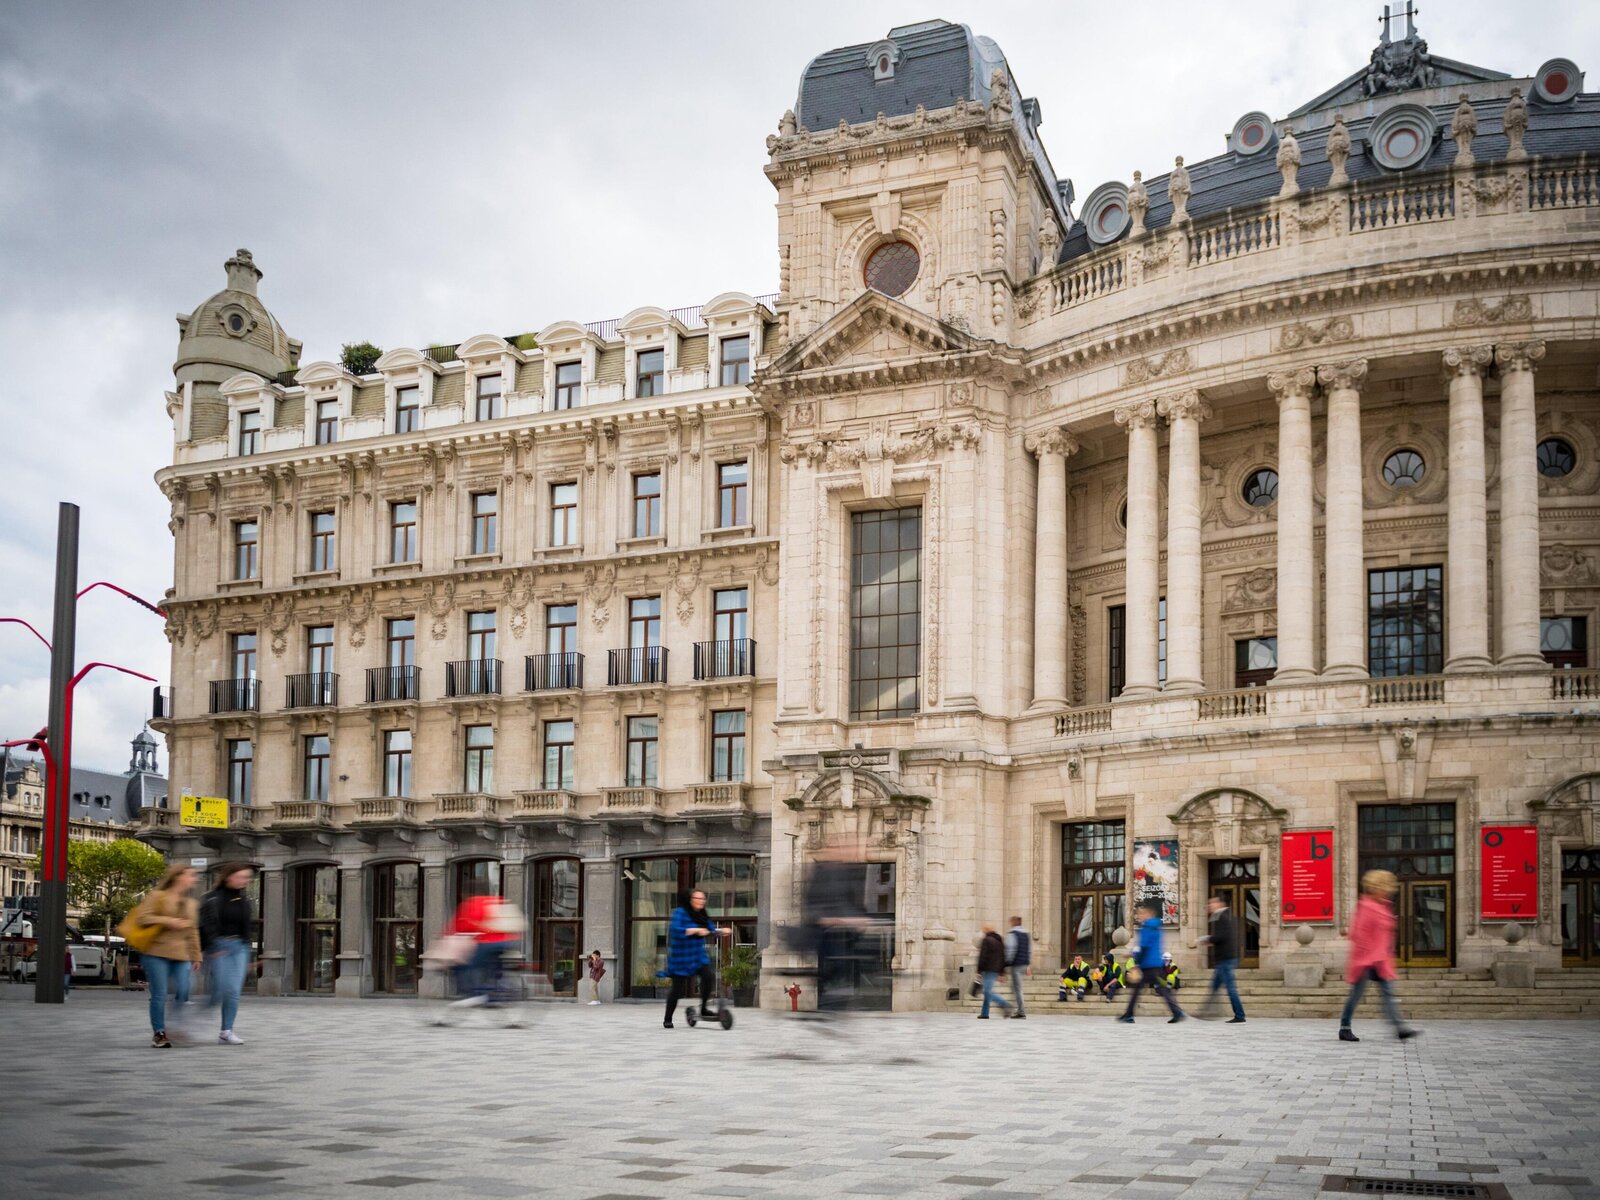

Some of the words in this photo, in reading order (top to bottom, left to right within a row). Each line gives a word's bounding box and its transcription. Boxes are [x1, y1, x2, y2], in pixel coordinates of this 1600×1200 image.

[1160, 844, 1170, 856] b
[1311, 836, 1330, 860] b
[1523, 860, 1536, 874] b
